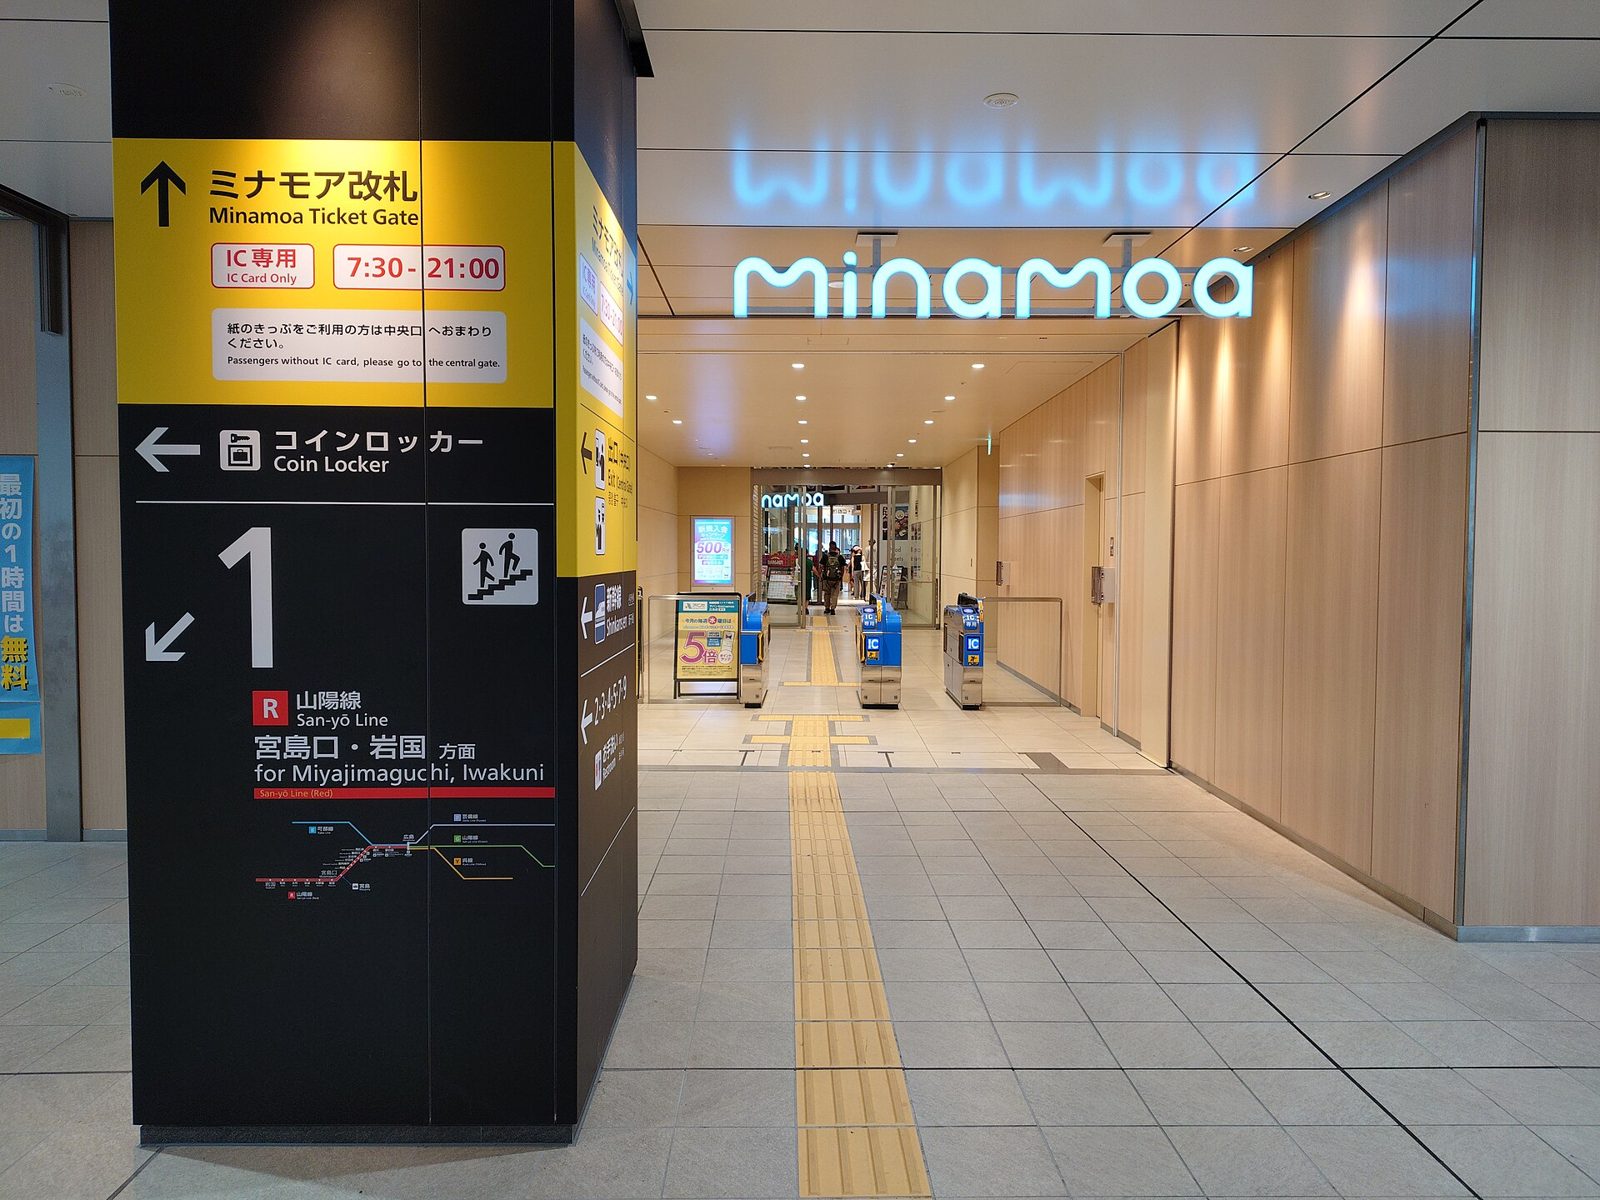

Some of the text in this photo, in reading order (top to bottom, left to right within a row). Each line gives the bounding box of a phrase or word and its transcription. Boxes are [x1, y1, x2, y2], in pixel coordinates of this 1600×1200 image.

[209, 170, 418, 201] ミナモア改札
[209, 207, 419, 226] Minamoa Ticket Gate
[226, 248, 297, 269] IC 専用
[226, 272, 297, 286] IC Card Only
[733, 251, 1253, 319] minamoa
[227, 337, 286, 350] ください。
[227, 356, 501, 370] Passengers without IC card, please go to the central gate.
[274, 431, 484, 453] コインロッカー
[273, 456, 389, 473] Coin Locker
[697, 542, 722, 553] 500
[217, 526, 274, 668] 1
[867, 639, 879, 649] IC
[968, 638, 979, 649] IC
[263, 698, 279, 719] R
[296, 691, 362, 710] 山陽線
[356, 713, 388, 727] Line
[438, 743, 476, 760] 方面
[254, 763, 544, 786] for Miyajimaguchi, Iwakuni
[290, 789, 309, 798] Line
[311, 789, 334, 799] (Red)
